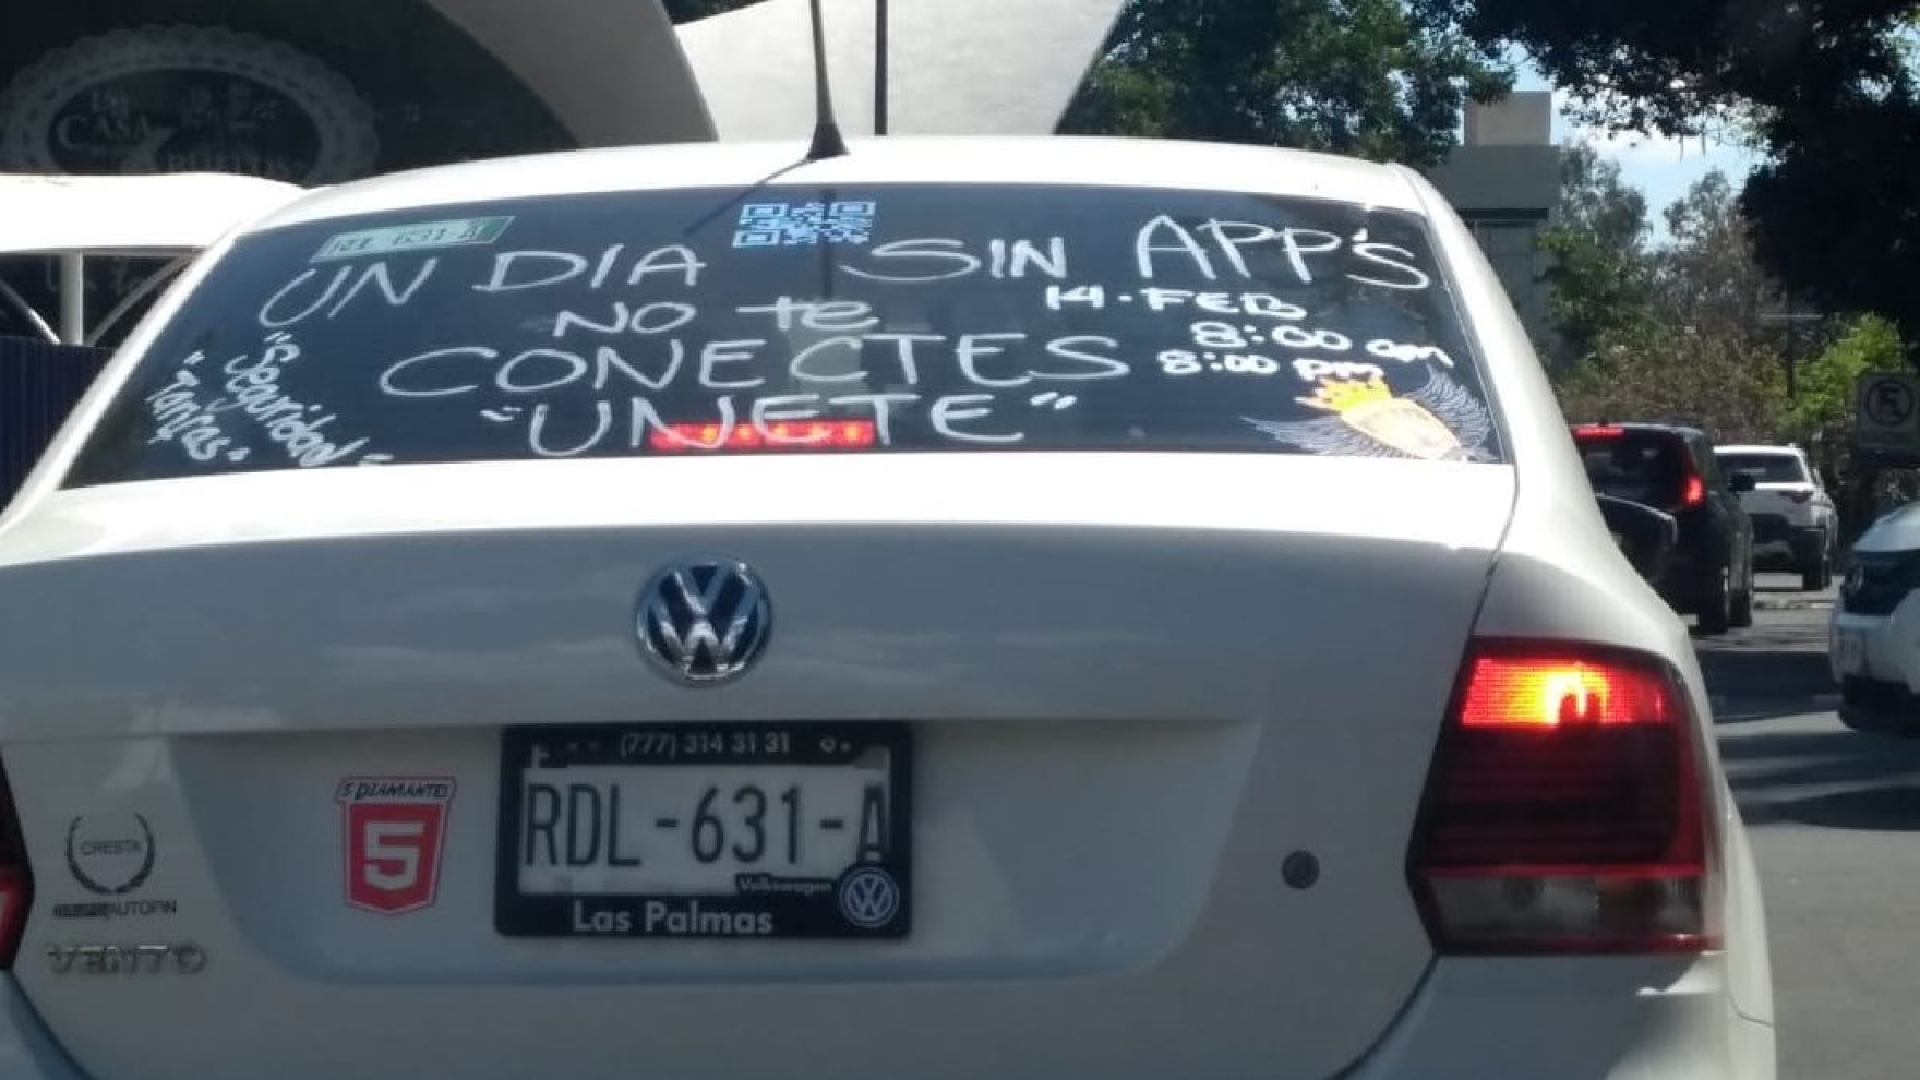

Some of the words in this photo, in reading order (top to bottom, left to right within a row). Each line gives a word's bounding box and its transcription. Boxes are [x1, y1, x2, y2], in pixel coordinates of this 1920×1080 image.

[260, 257, 438, 328] UN
[472, 243, 706, 291] DIA
[840, 237, 1067, 281] SIN
[1136, 214, 1431, 290] APP'S
[553, 301, 697, 337] NO
[736, 296, 880, 331] te
[380, 334, 1130, 396] CONECTES
[1190, 322, 1352, 350] 8:00
[1366, 338, 1454, 368] am
[1157, 350, 1280, 376] 8:00
[1292, 357, 1384, 383] pm
[622, 732, 677, 758] (777)
[685, 733, 724, 754] 314
[732, 733, 757, 754] 31
[766, 732, 790, 754] 31
[525, 783, 889, 866] RDL-631-A
[80, 839, 142, 856] CRESTA
[363, 821, 425, 889] 5
[573, 900, 630, 932] Las
[645, 899, 774, 934] Palmas
[46, 941, 207, 974] VENTO
